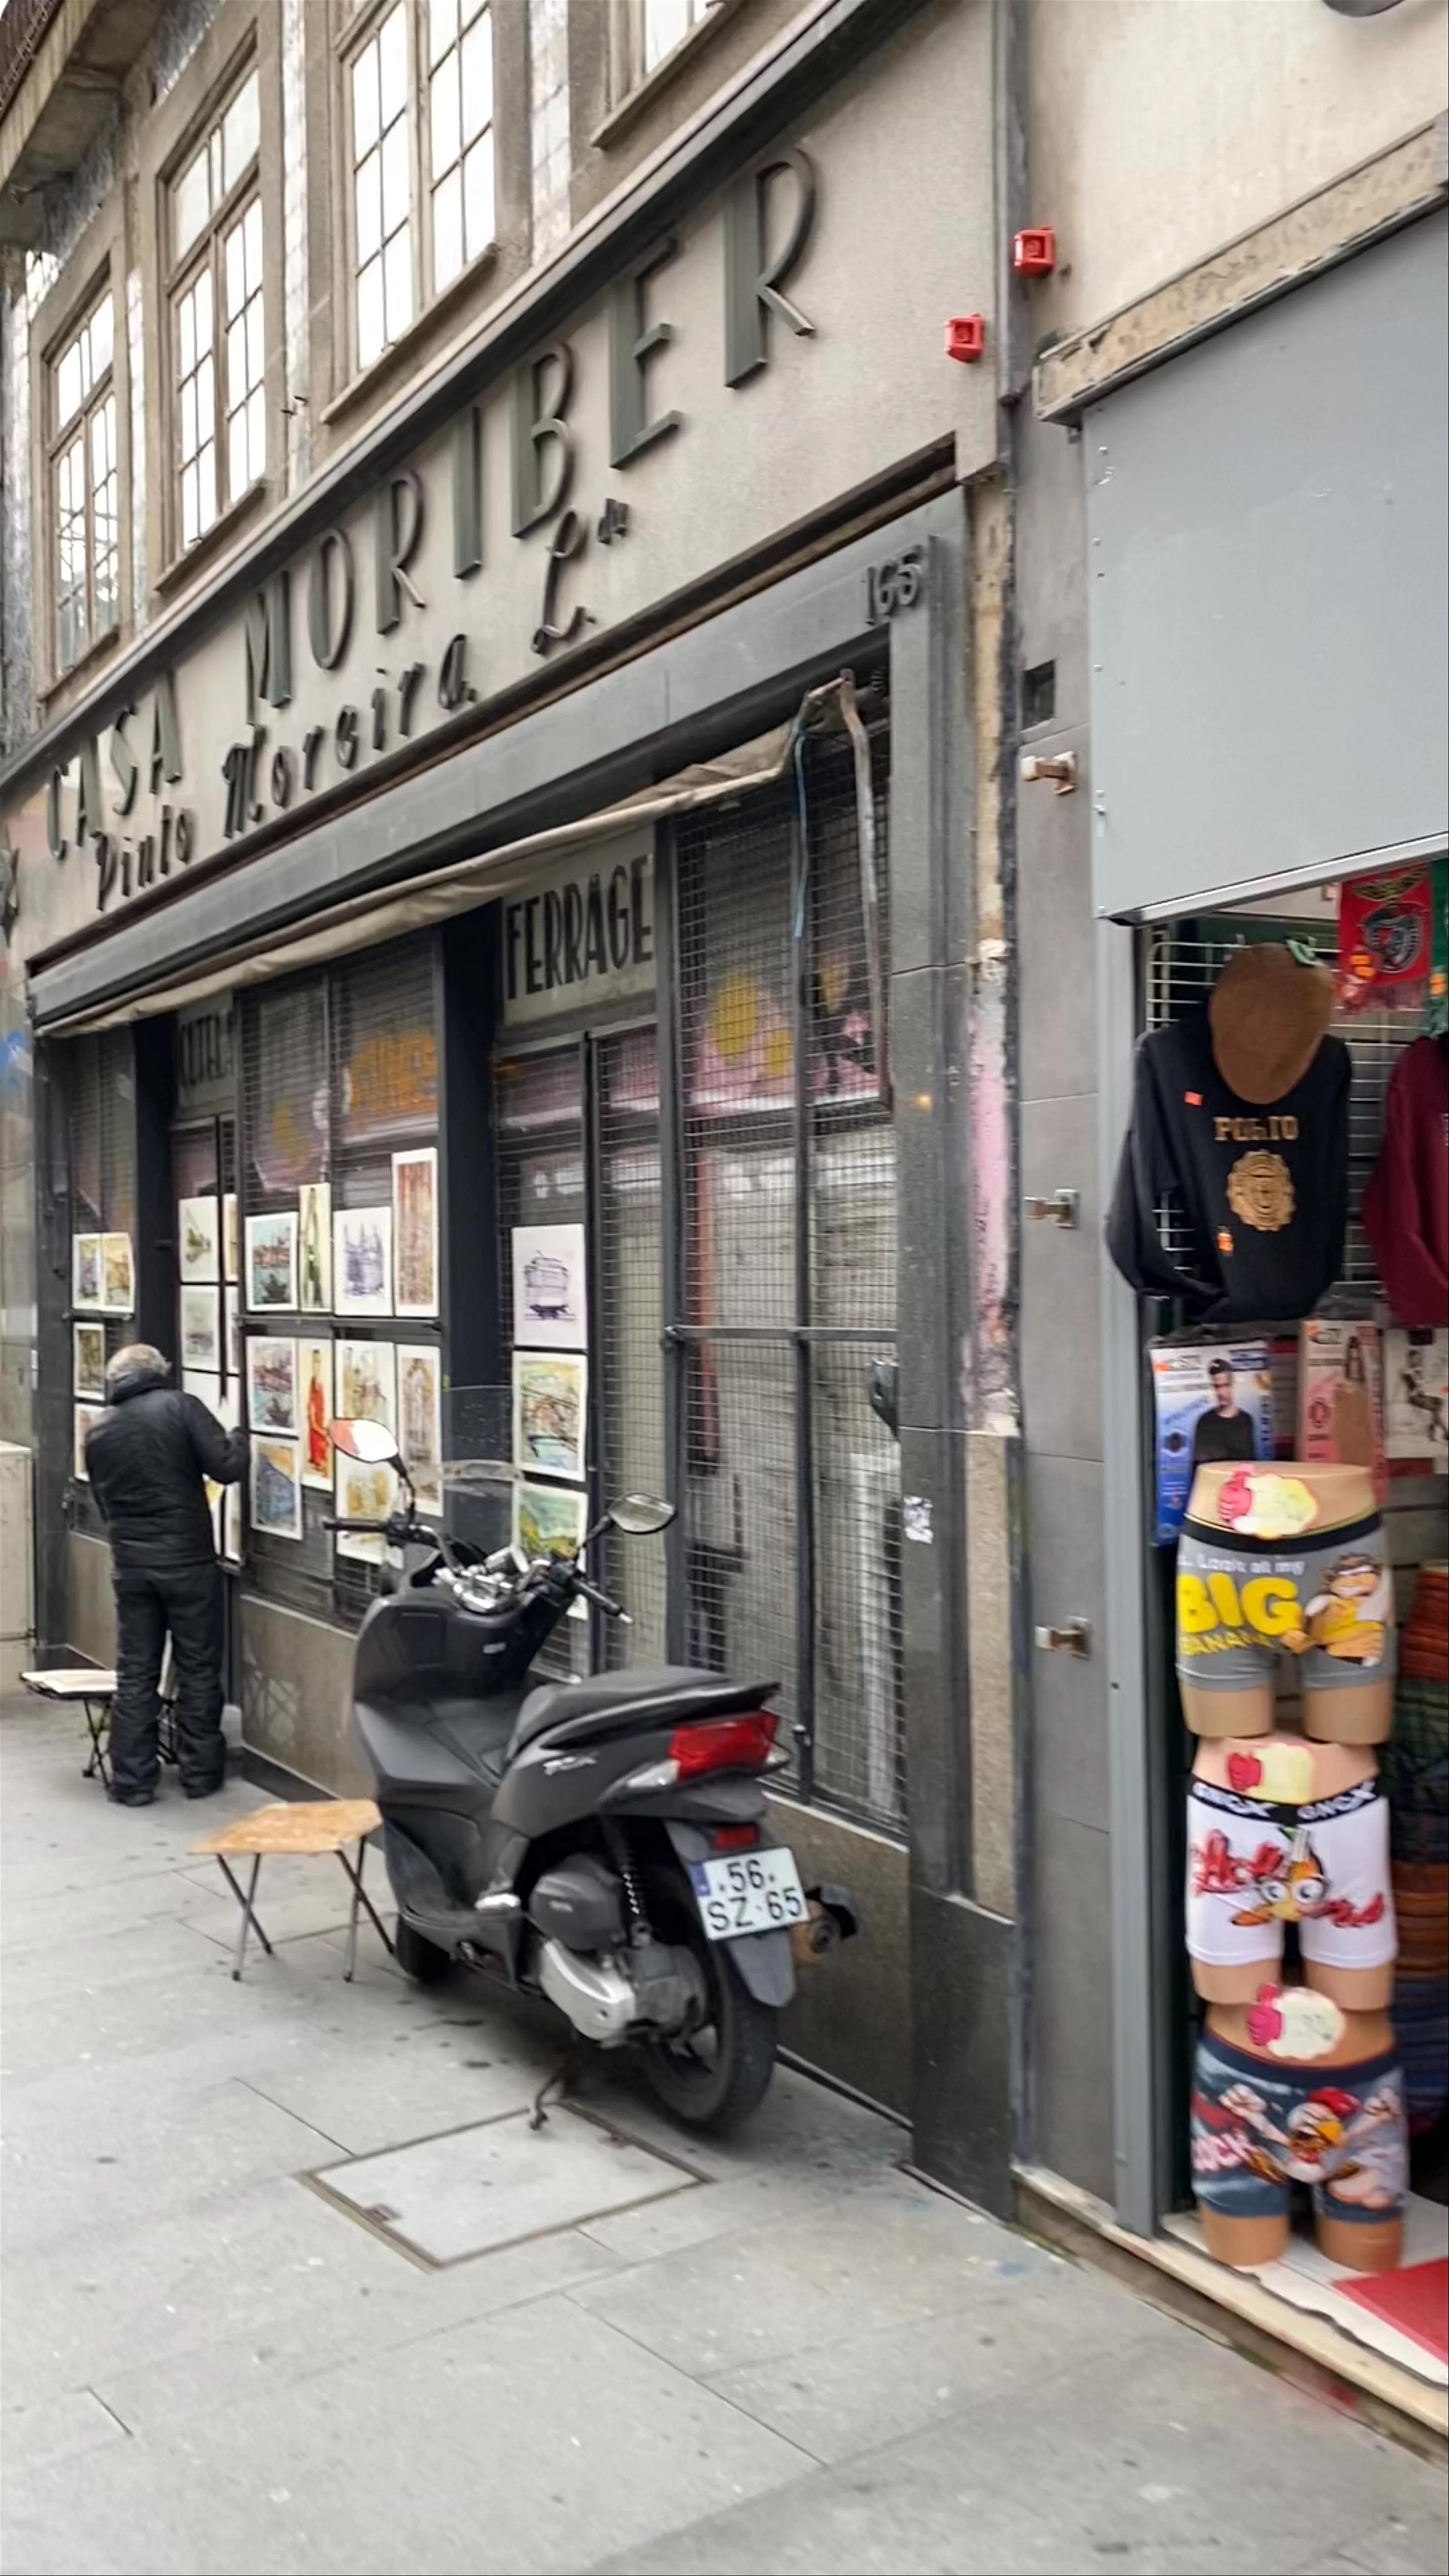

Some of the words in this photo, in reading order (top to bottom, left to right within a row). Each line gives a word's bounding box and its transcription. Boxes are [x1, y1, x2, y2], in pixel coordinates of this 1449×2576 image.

[47, 665, 183, 861] CASA
[245, 147, 817, 726] MORIBER
[866, 545, 923, 626] 165
[96, 804, 196, 911] Pinto
[506, 854, 654, 1001] FERRAGE
[1177, 1573, 1302, 1636] BIG
[726, 1859, 764, 1892] 56
